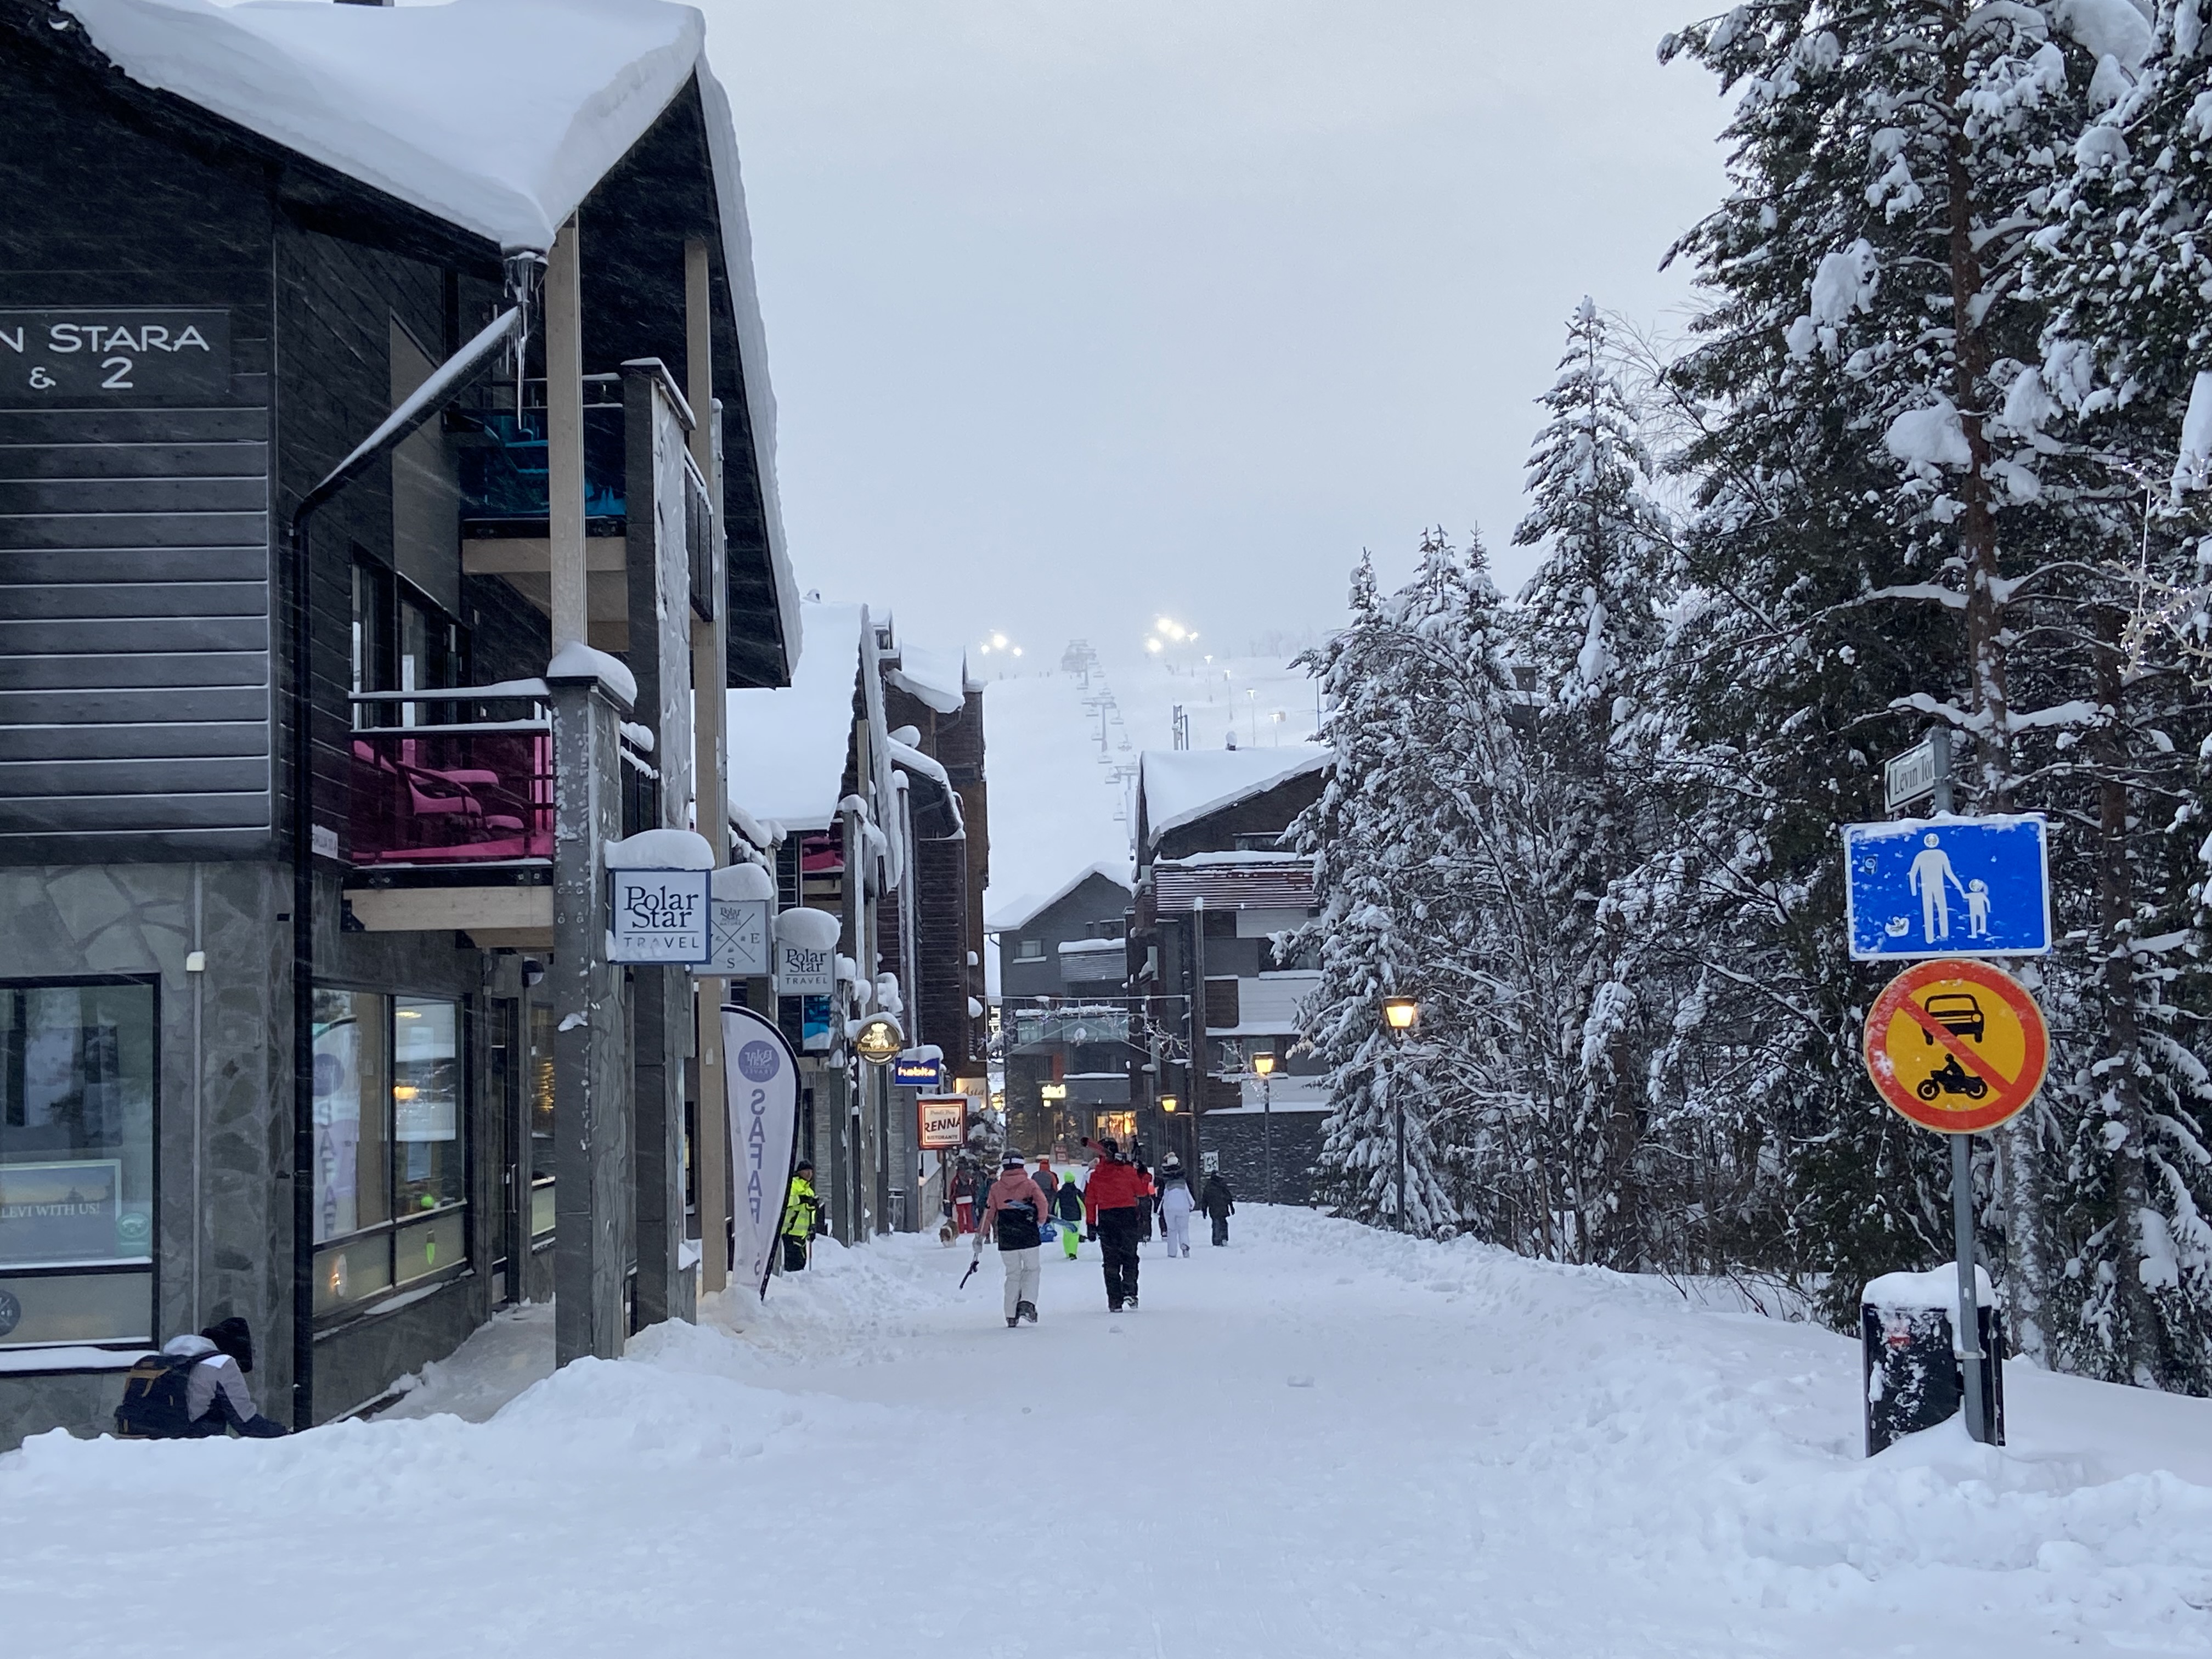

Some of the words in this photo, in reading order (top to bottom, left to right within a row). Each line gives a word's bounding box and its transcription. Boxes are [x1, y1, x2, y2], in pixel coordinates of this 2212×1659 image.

[48, 323, 210, 353] STARA
[29, 366, 56, 389] &
[101, 356, 133, 388] 2
[1894, 767, 1918, 795] Levin
[623, 885, 699, 911] Polar
[632, 902, 692, 928] Star
[623, 936, 699, 949] TRAVEL
[751, 933, 760, 944] E
[786, 948, 827, 963] Polar
[726, 958, 735, 969] S
[789, 958, 823, 973] Star
[786, 977, 827, 985] TRAVEL
[962, 1085, 985, 1096] Asia
[1, 1205, 32, 1218] LEVI
[36, 1204, 75, 1217] WITH
[78, 1202, 100, 1215] US!
